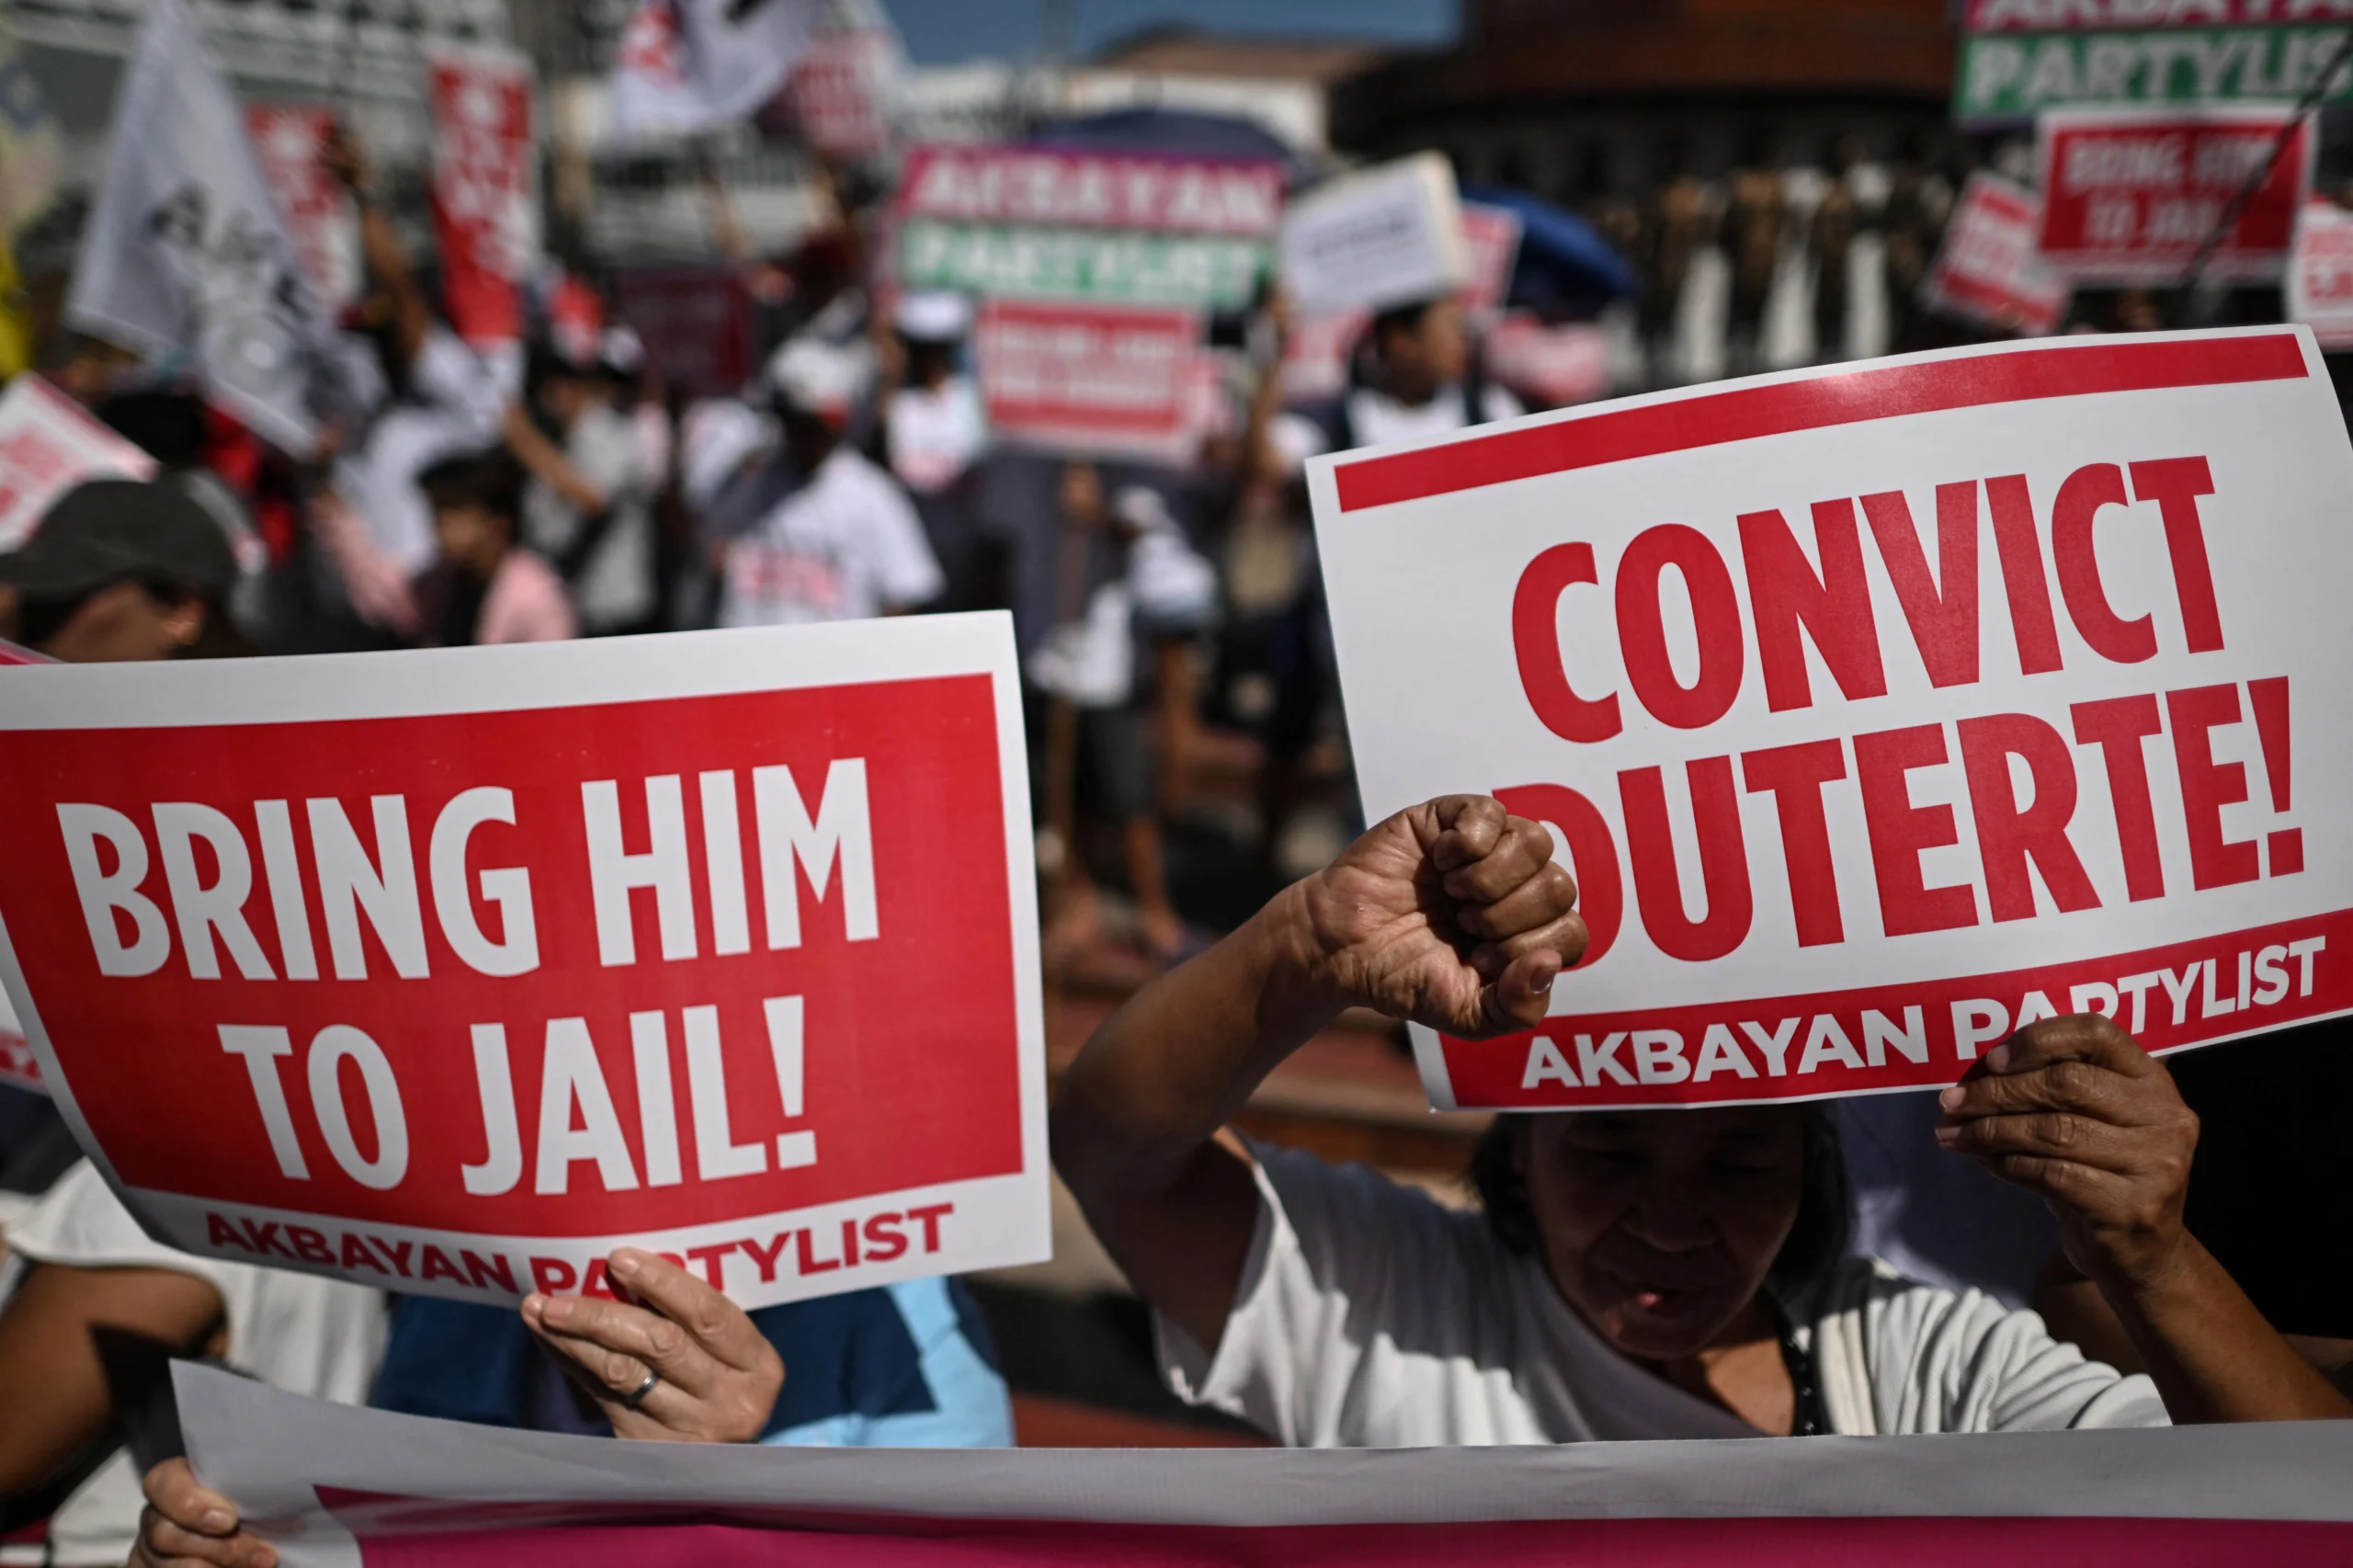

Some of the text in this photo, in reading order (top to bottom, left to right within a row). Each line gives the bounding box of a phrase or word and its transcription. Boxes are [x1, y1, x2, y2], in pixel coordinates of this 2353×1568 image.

[1512, 455, 2224, 744] CONVICT
[55, 757, 880, 982] BRING HIM
[1492, 675, 2304, 972] DUTERTE!
[217, 994, 818, 1197] TO JAIL!
[1521, 1006, 1929, 1090] AKBAYAN
[205, 1202, 954, 1303] AKBAYAN PATYLIST
